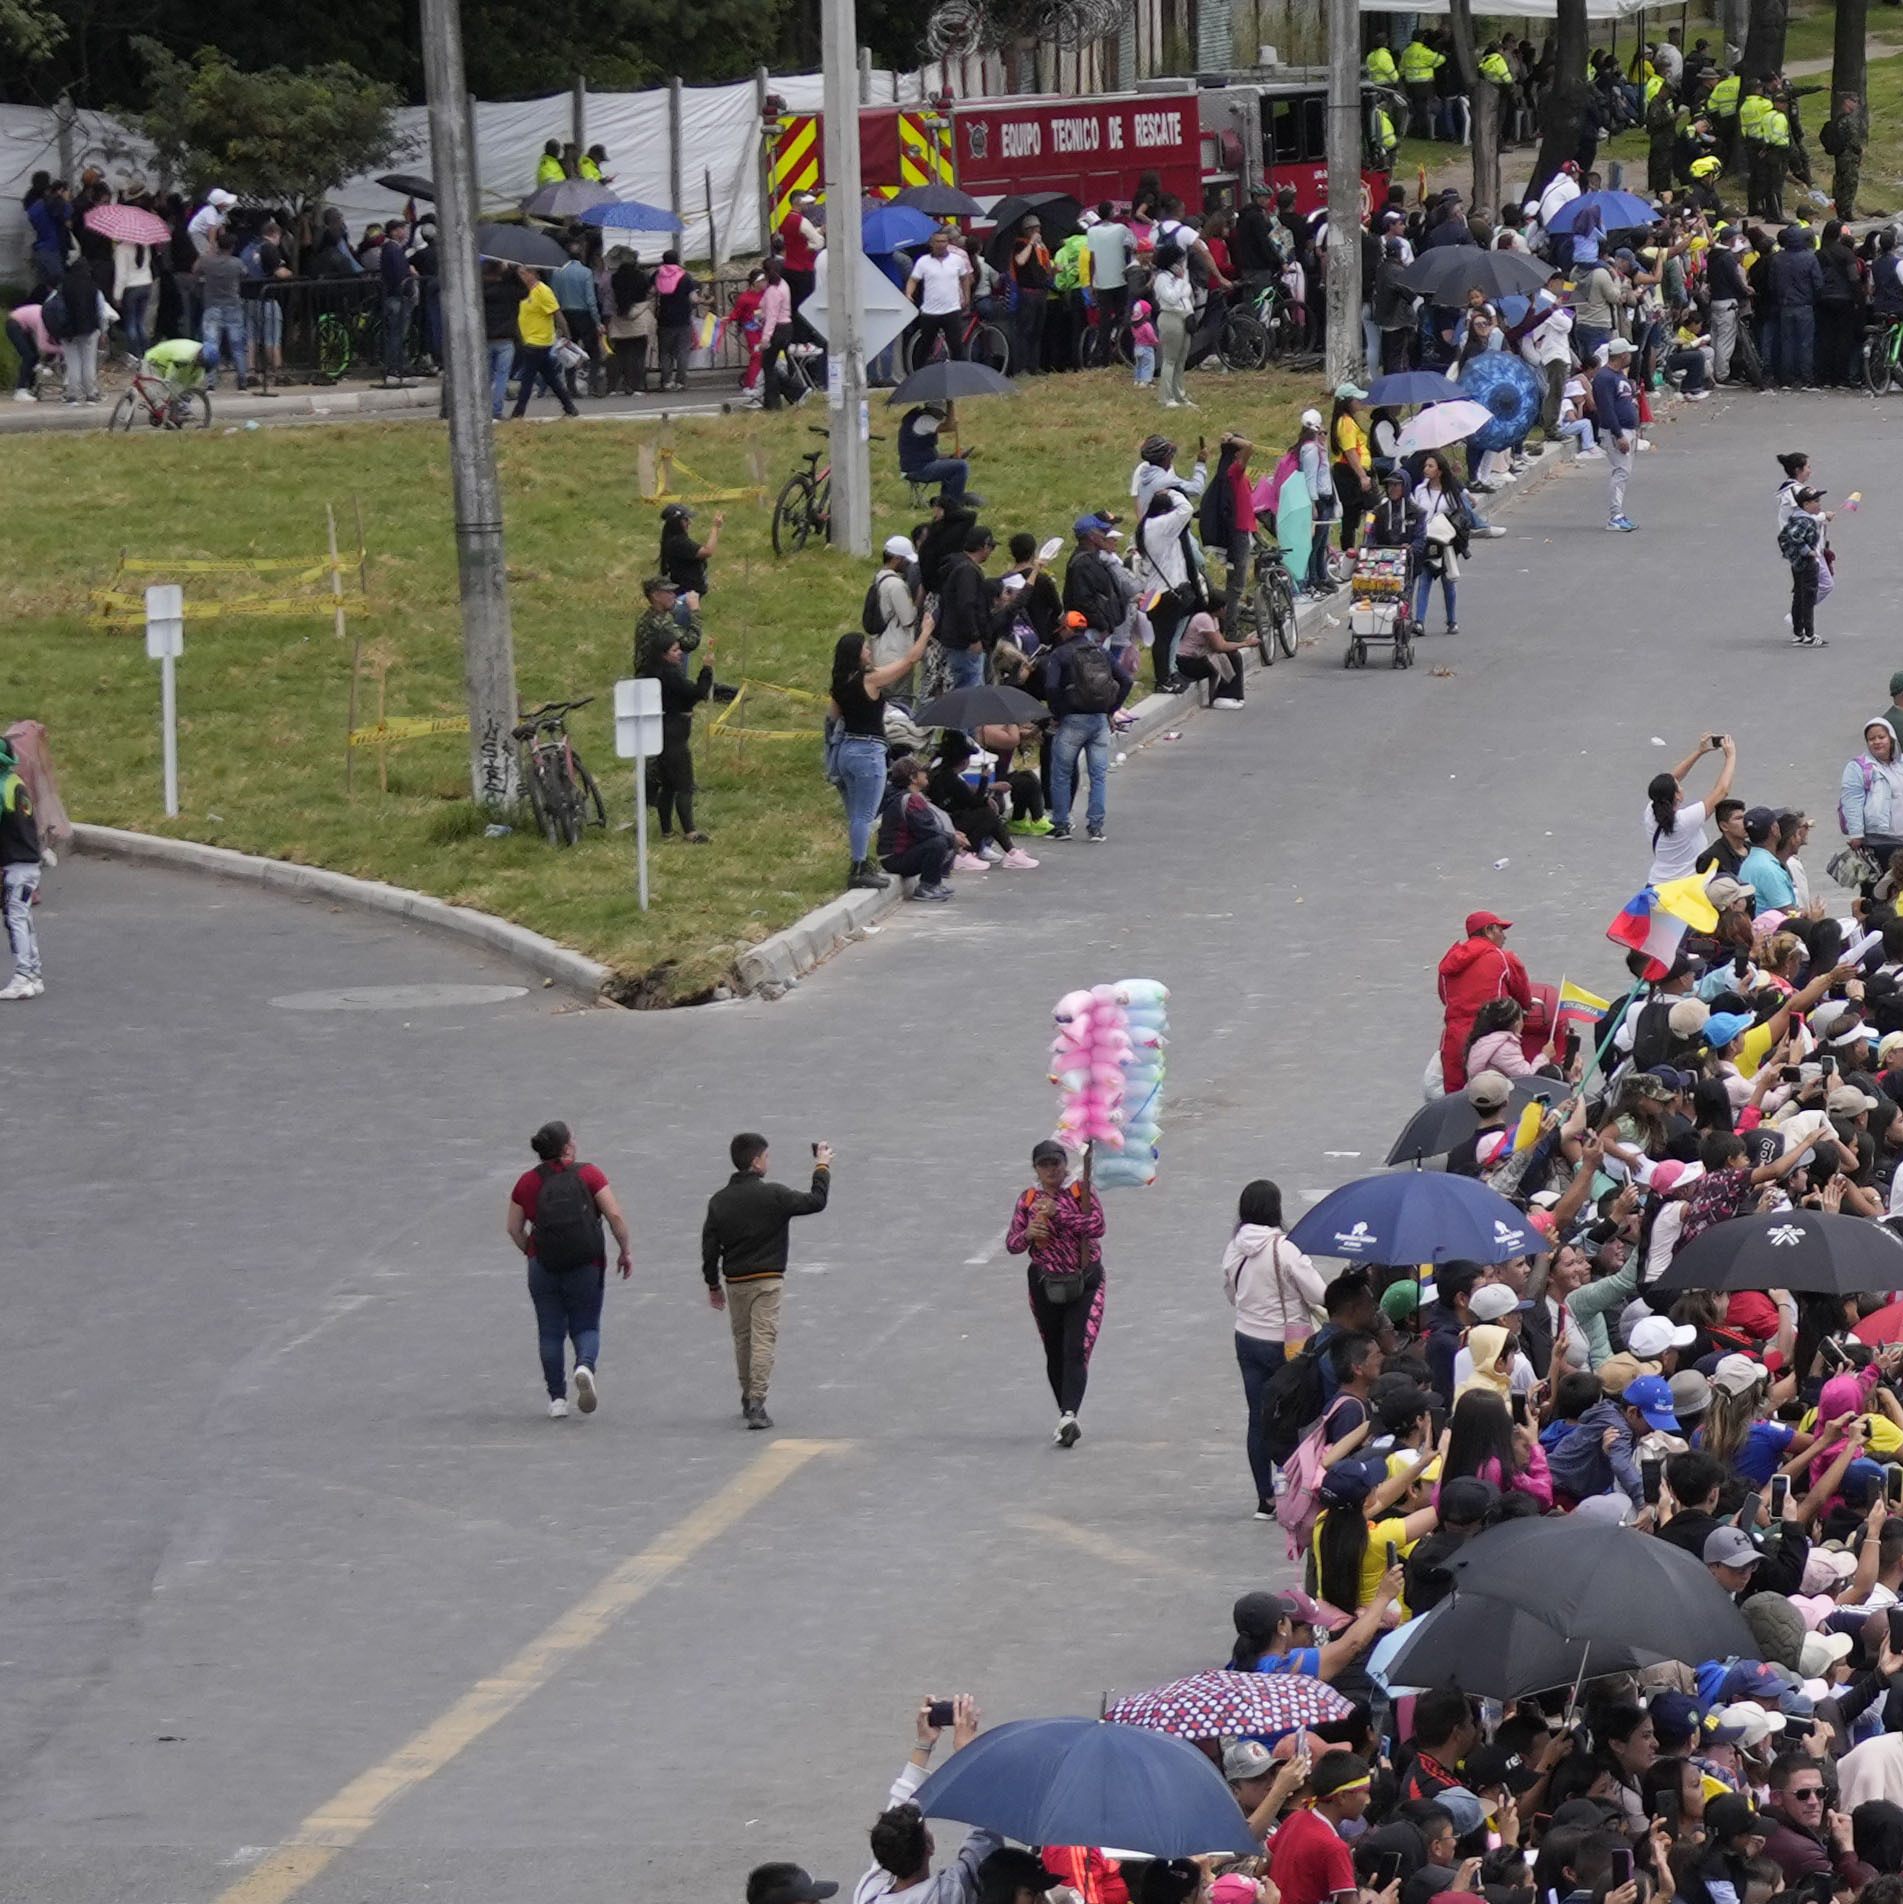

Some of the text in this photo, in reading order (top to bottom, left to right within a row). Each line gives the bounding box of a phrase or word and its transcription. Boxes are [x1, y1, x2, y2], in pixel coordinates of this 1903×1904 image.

[1001, 111, 1183, 157] EQUIPO TECNICO DE RESCATE
